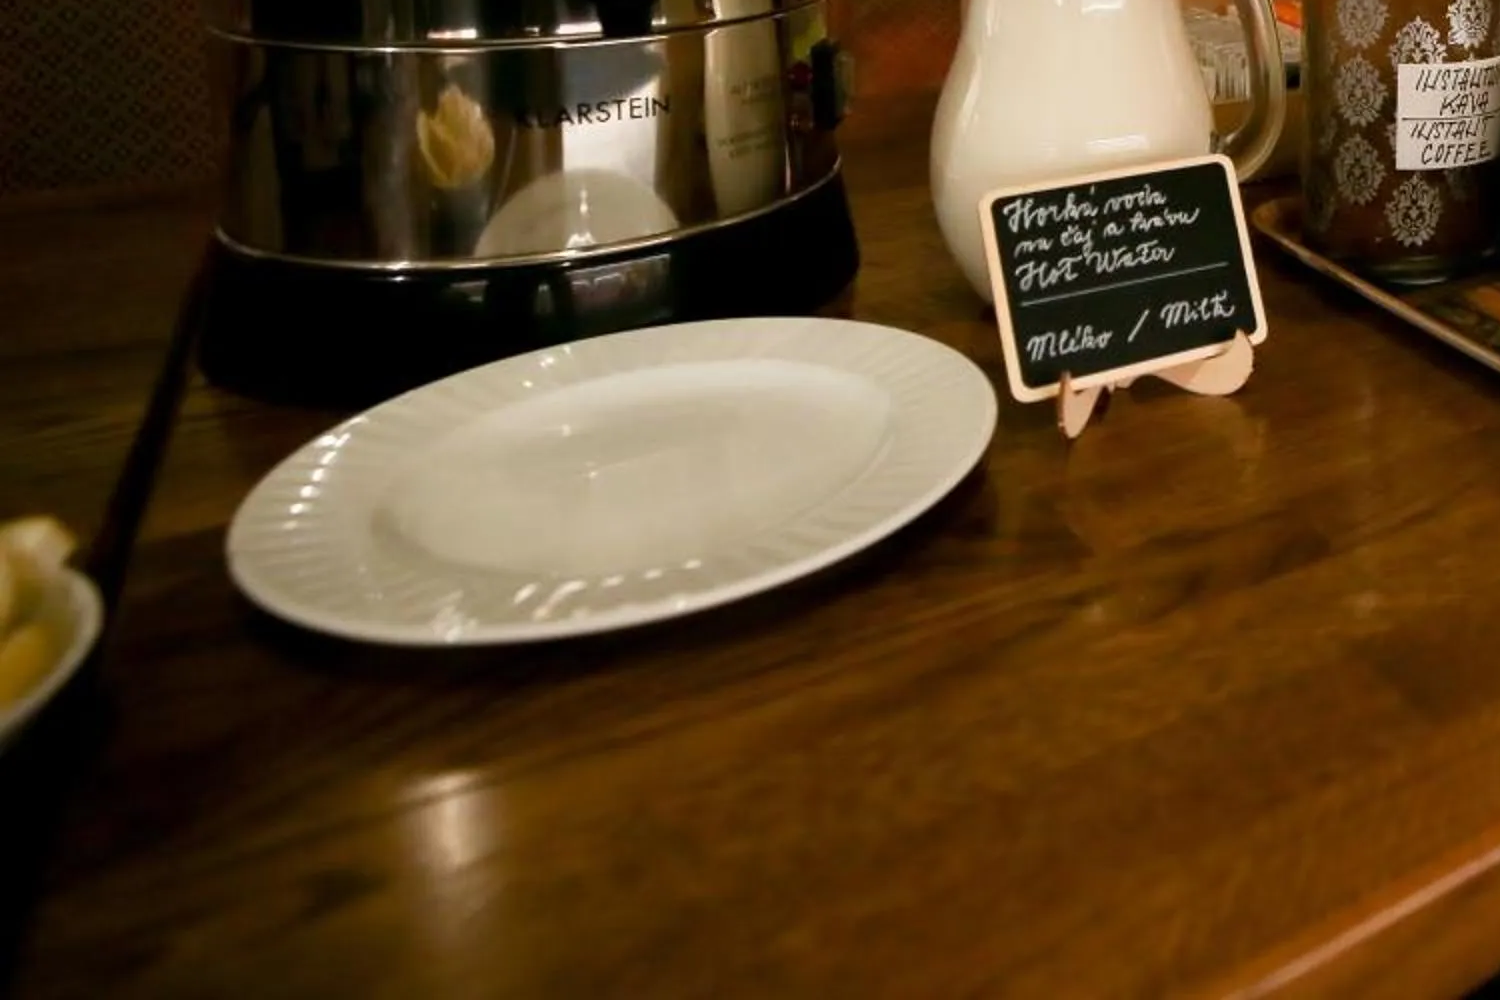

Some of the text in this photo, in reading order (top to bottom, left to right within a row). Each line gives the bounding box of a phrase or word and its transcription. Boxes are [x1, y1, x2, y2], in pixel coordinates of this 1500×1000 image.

[514, 95, 671, 130] KLARSTEIN
[1421, 140, 1491, 165] COFFEE
[1103, 183, 1167, 215] voda
[1103, 223, 1125, 238] a
[1015, 239, 1176, 292] Hot Water
[1025, 324, 1114, 361] Mléko
[1159, 289, 1236, 329] Milk
